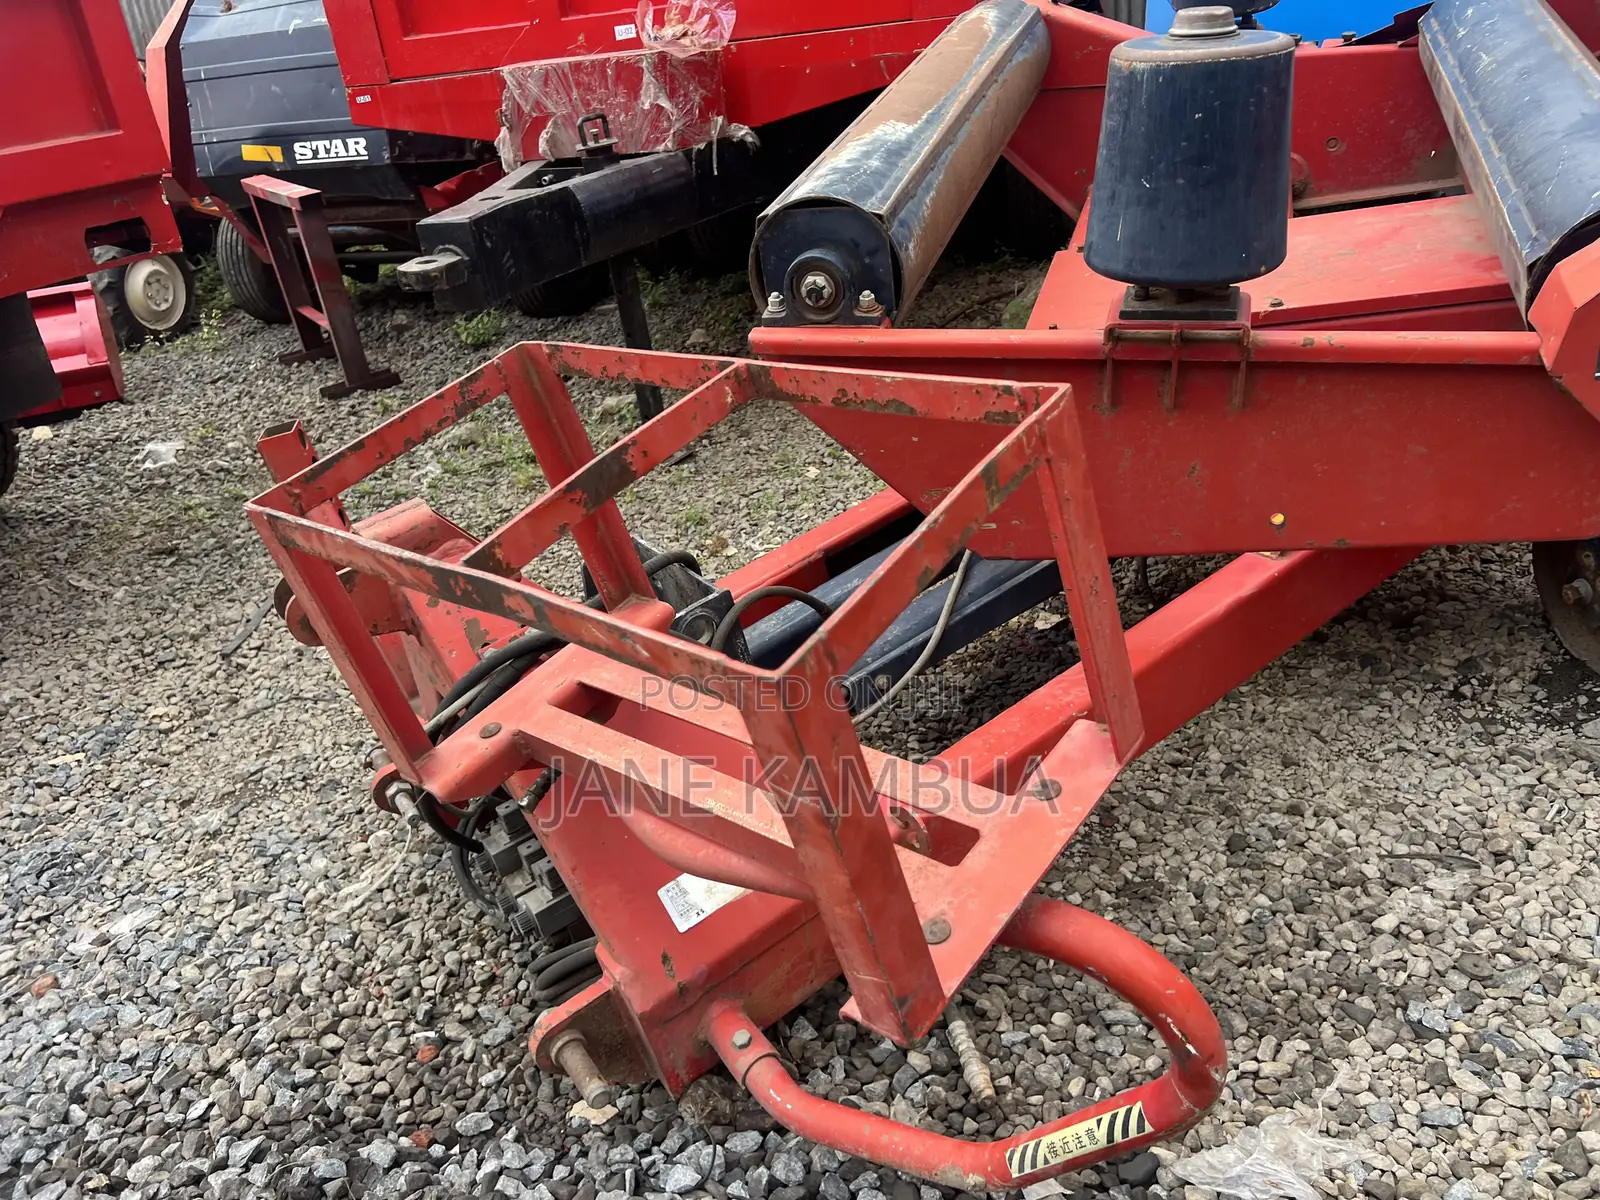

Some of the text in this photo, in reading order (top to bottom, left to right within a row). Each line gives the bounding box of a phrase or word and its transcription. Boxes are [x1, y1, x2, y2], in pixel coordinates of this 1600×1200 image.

[617, 26, 633, 37] U-02
[293, 137, 368, 160] STAR
[1046, 1127, 1100, 1159] 接近注意
